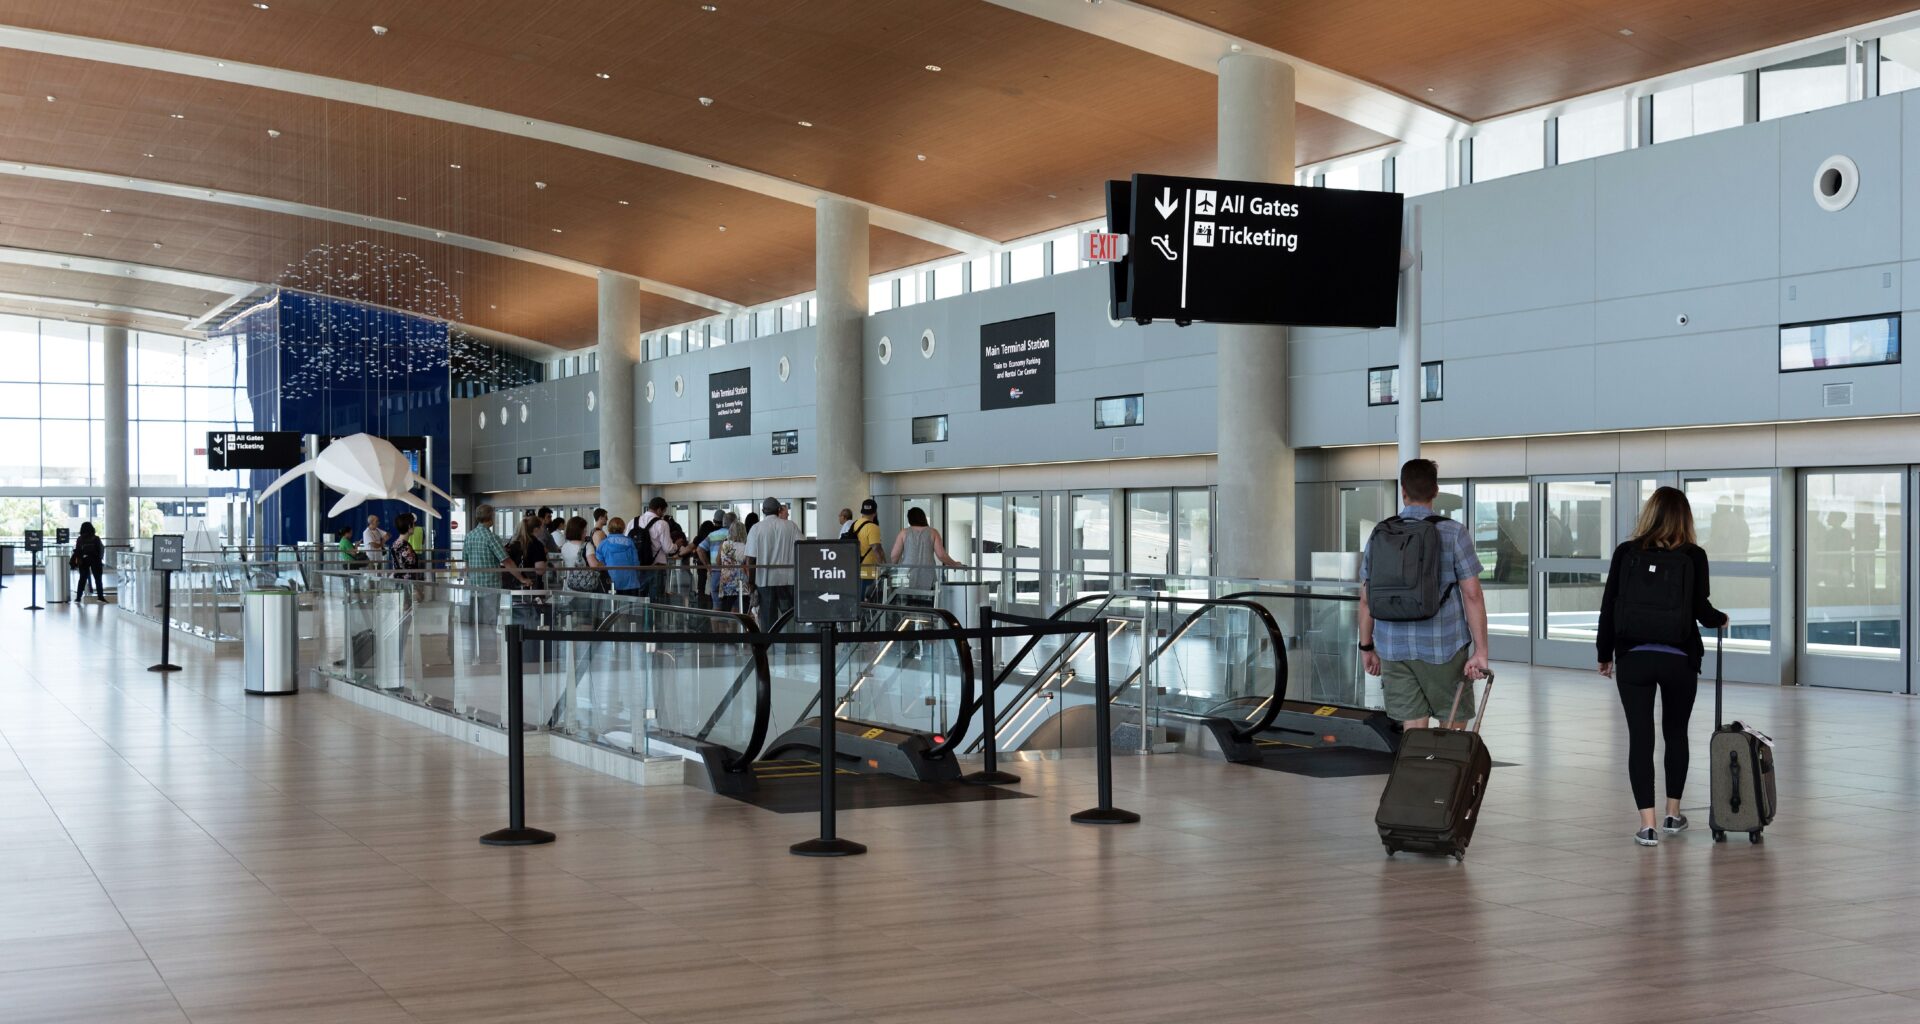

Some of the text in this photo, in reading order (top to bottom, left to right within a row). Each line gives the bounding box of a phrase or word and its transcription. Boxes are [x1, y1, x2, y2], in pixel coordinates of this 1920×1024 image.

[1220, 197, 1299, 218] All Gates
[1219, 226, 1299, 252] Ticketing
[1090, 233, 1118, 259] EXIT
[985, 338, 1049, 357] Main Terminal Station
[1026, 357, 1041, 366] Parking
[1005, 370, 1016, 378] Rental
[237, 443, 265, 451] Ticketing
[820, 548, 837, 560] To
[811, 566, 846, 579] Train
